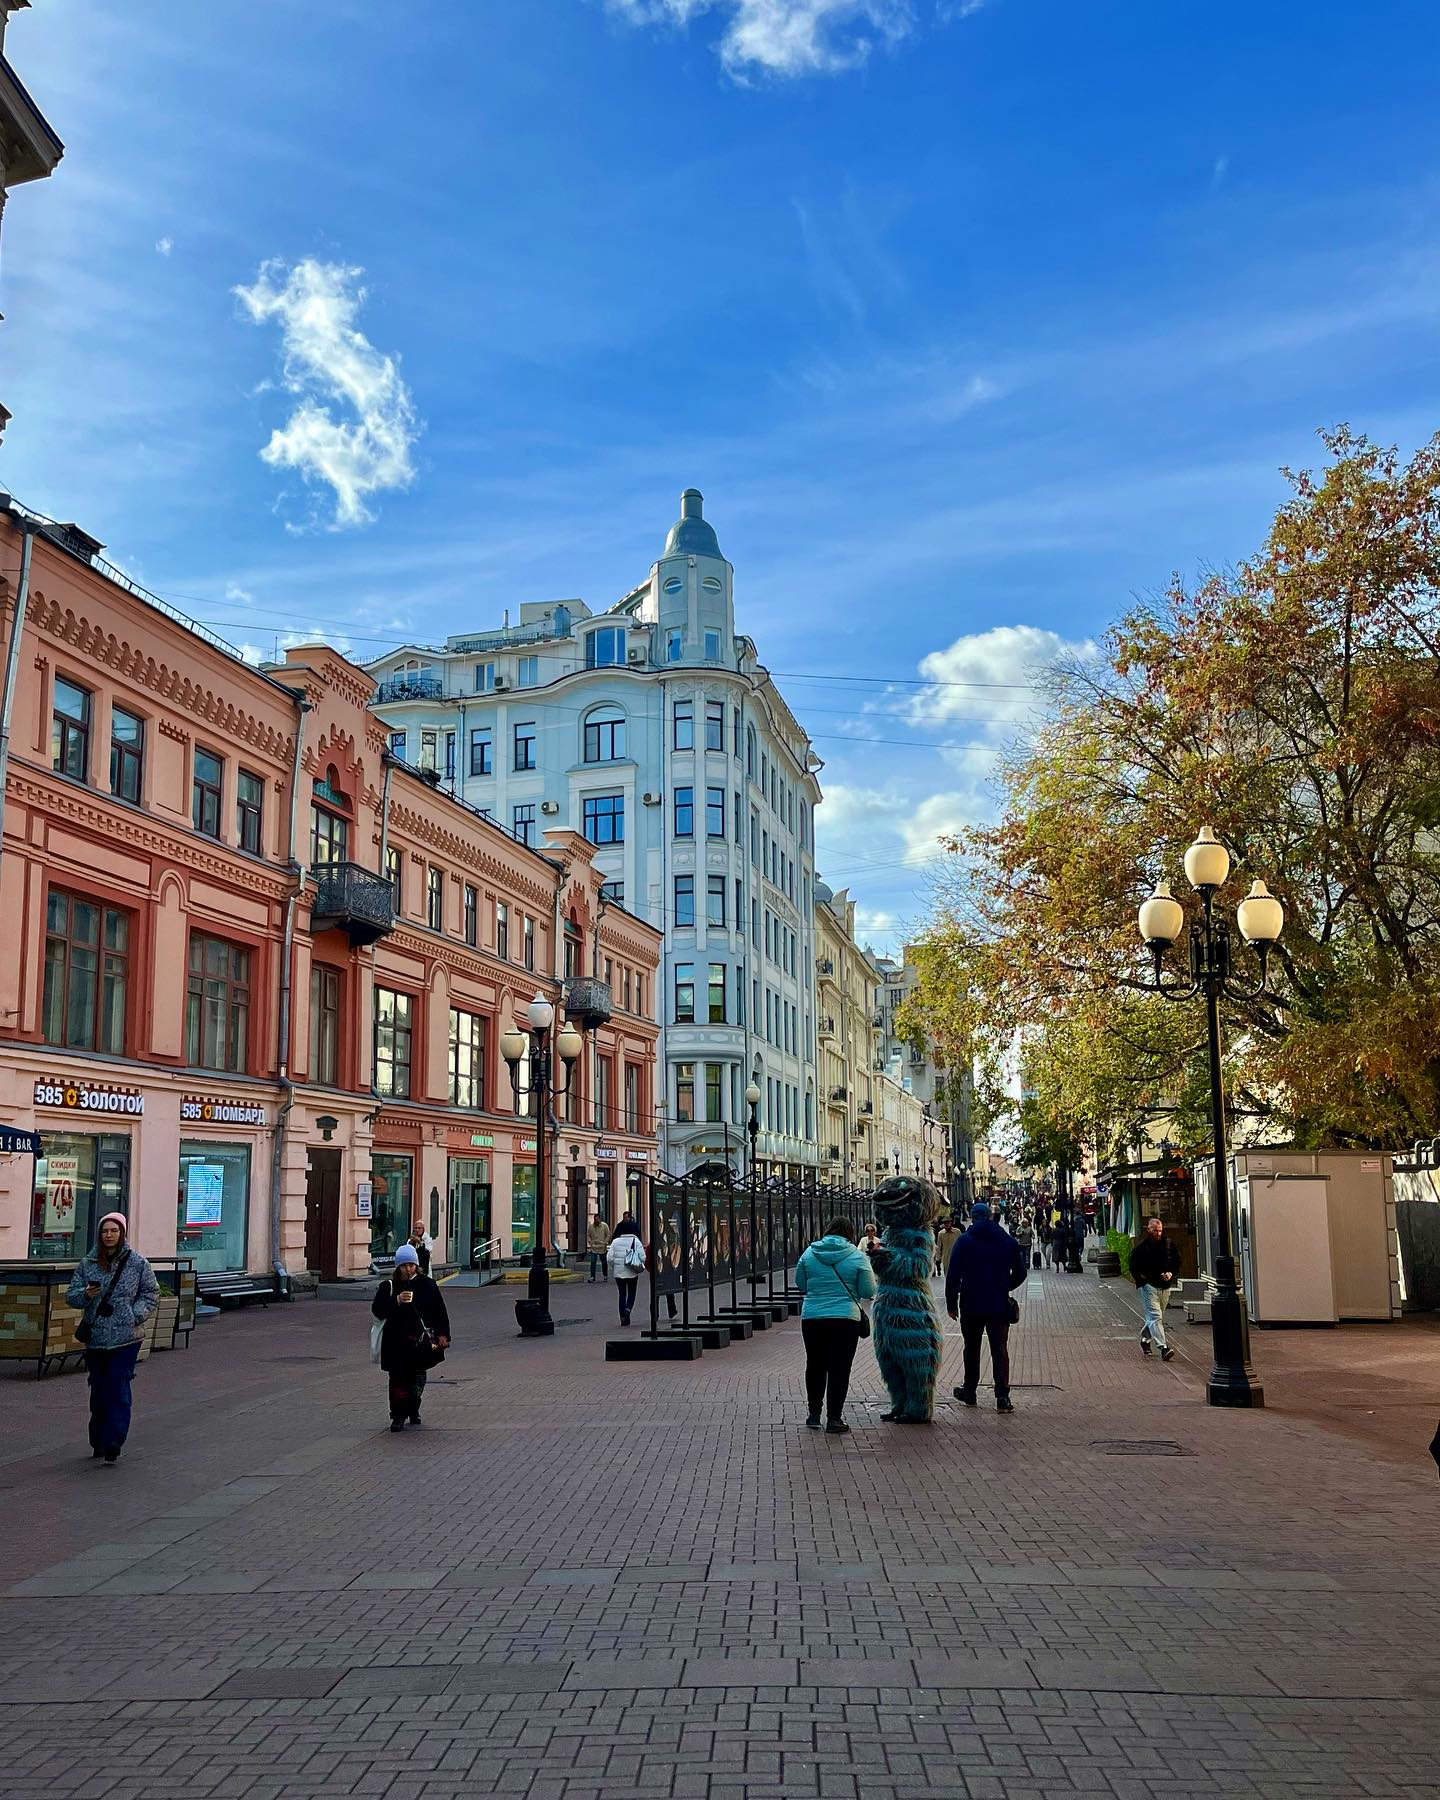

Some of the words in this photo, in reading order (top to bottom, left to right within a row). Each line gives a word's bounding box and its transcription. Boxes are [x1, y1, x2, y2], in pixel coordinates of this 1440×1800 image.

[36, 1084, 63, 1105] 585
[80, 1090, 145, 1113] ЗОЛОТОЙ
[183, 1103, 202, 1119] 585
[213, 1105, 266, 1125] ЛОМБАРД
[16, 1138, 33, 1151] BAR
[50, 1161, 77, 1170] СКИДКИ
